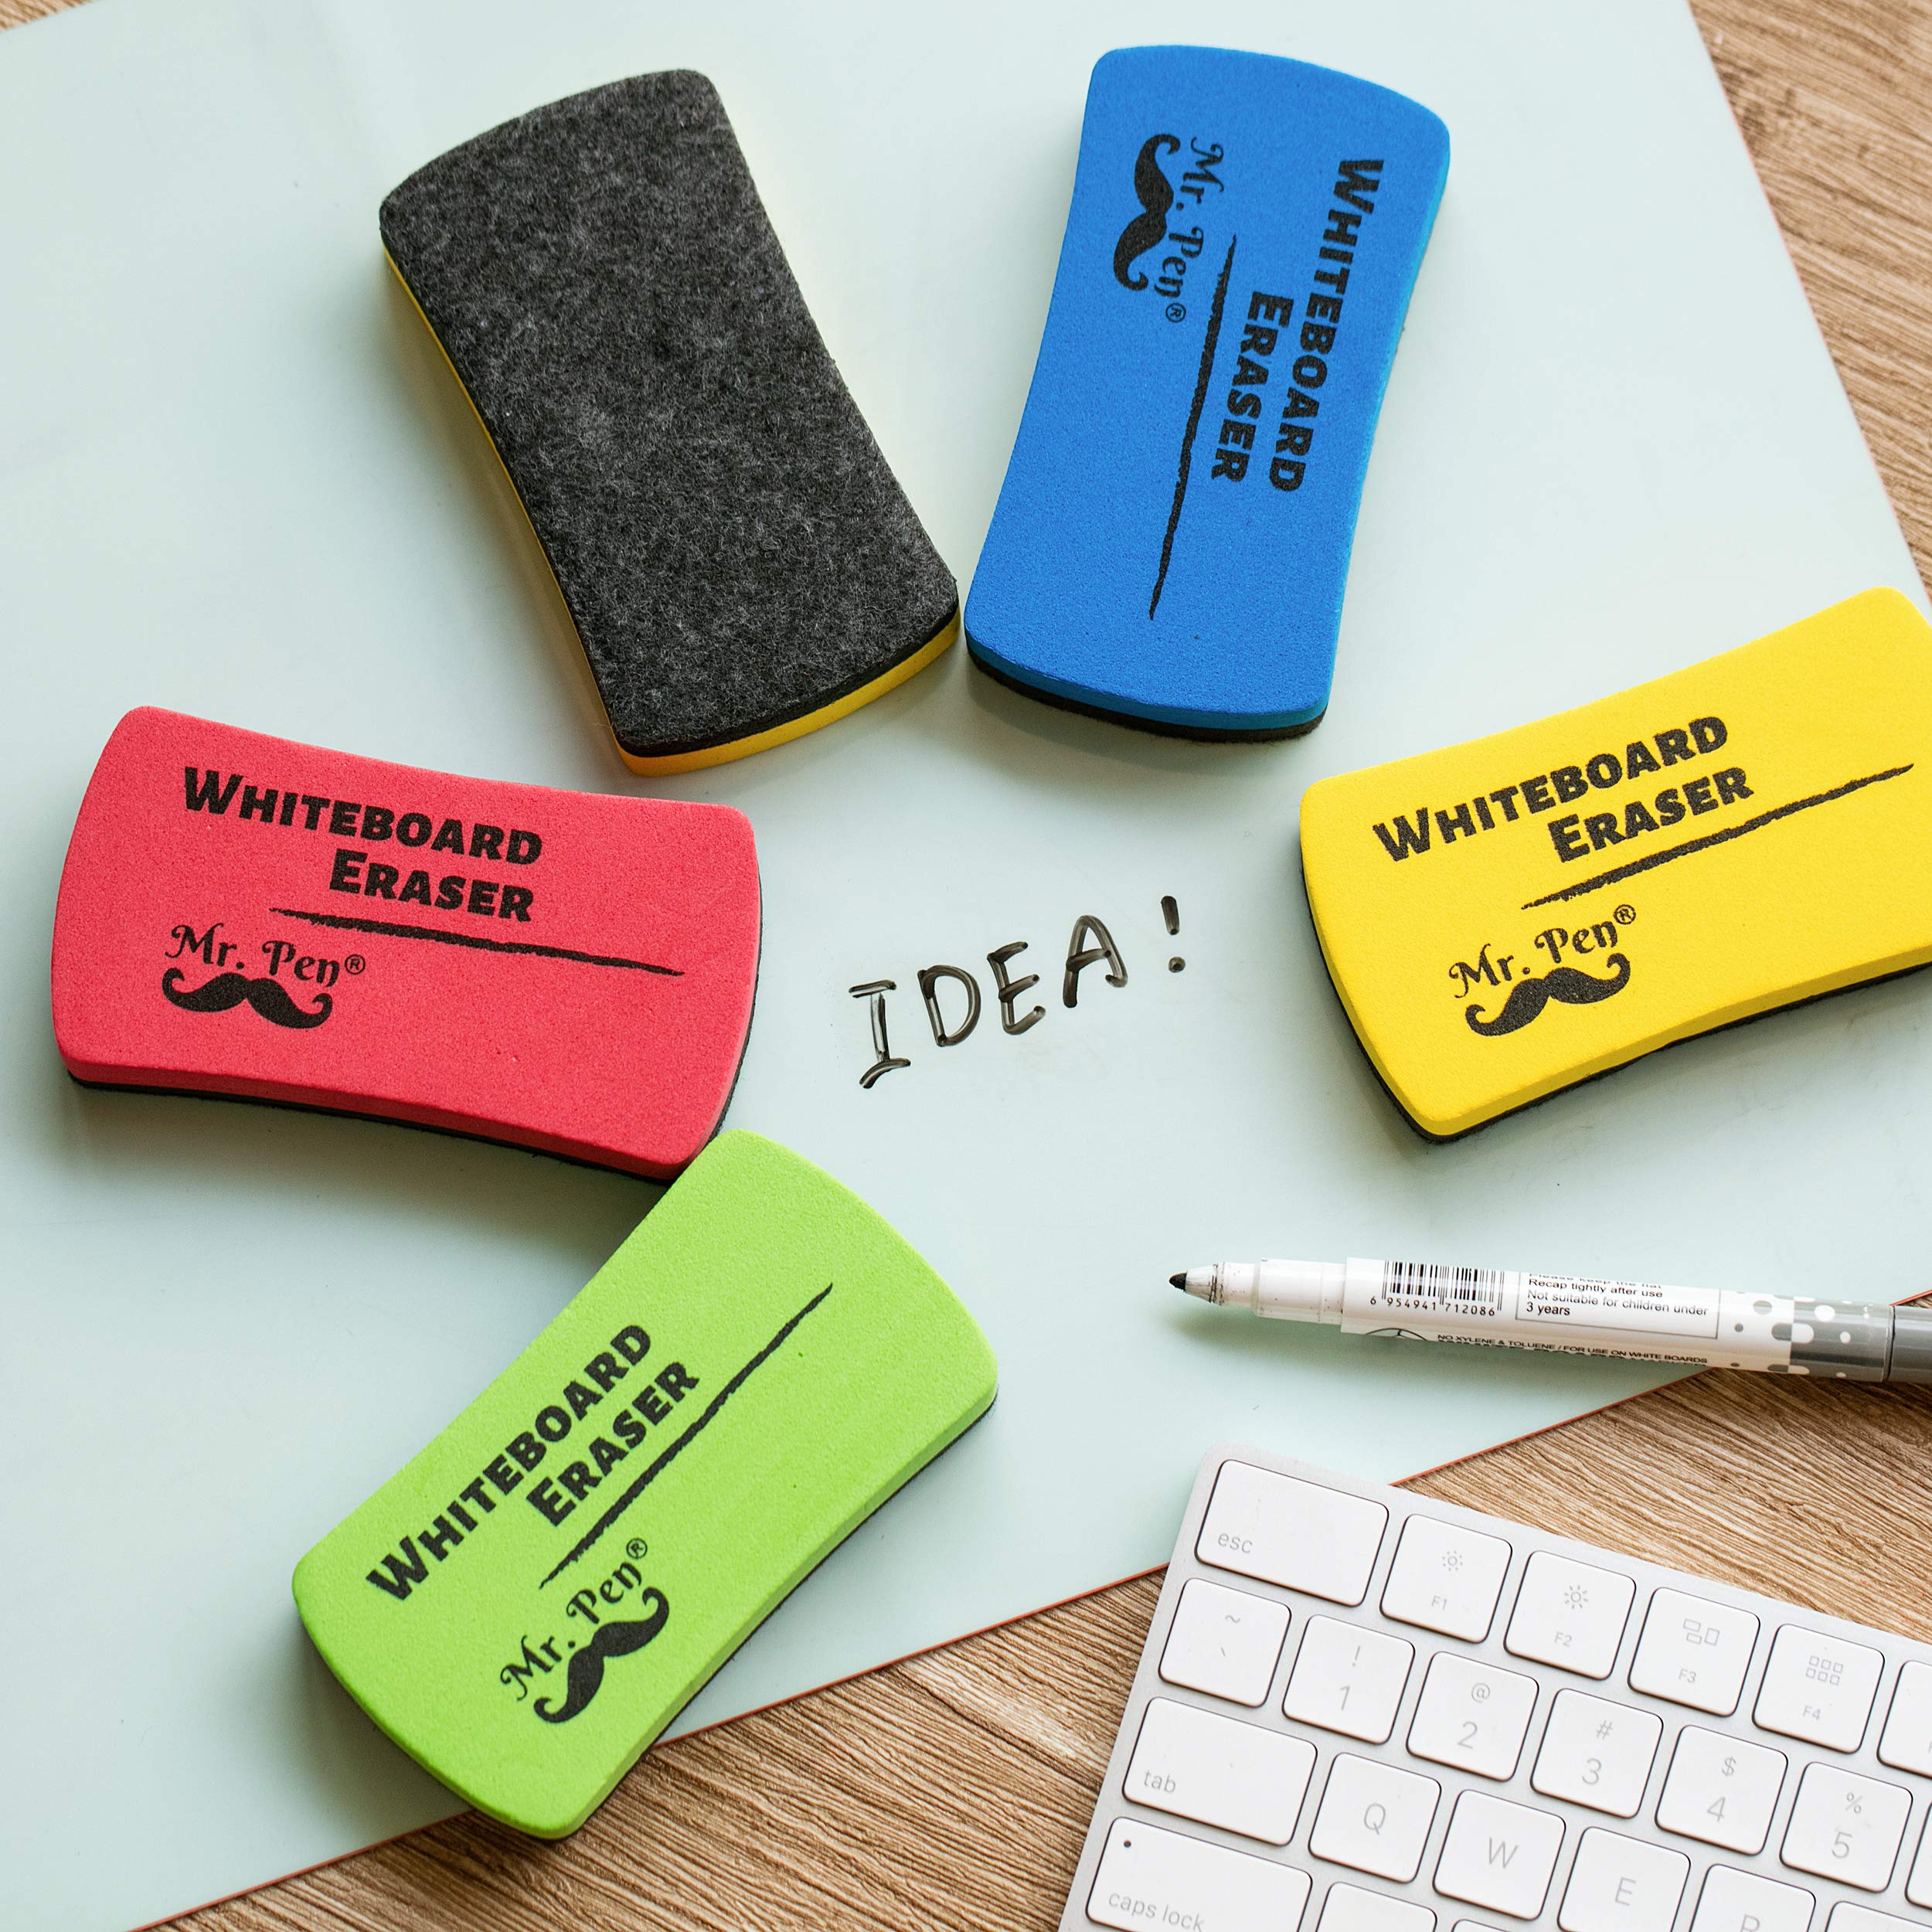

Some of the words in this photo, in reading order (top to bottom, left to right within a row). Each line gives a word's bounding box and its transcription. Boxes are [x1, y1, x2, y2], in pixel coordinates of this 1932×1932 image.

[1175, 136, 1224, 212] Mr.
[164, 923, 245, 970] Mr.
[1449, 943, 1531, 998] Mr.
[1529, 1278, 1567, 1290] Recap
[1571, 1283, 1607, 1293] tightly
[1611, 1287, 1637, 1295] after
[1526, 1301, 1533, 1312] 3
[1537, 1304, 1570, 1316] years
[1527, 1289, 1549, 1301] Not
[1552, 1291, 1599, 1305] suitable
[1603, 1296, 1618, 1308] for
[1622, 1298, 1669, 1312] children
[1673, 1304, 1708, 1316] under
[1455, 1335, 1496, 1345] XYLENE
[1508, 1340, 1556, 1350] TOLUENE
[1628, 1352, 1662, 1360] WHITE
[1664, 1355, 1708, 1364] BOARDS
[1217, 1532, 1253, 1555] esc
[1430, 1595, 1447, 1611] F1
[1554, 1631, 1573, 1648] F2
[499, 1634, 577, 1701] Mr.
[1678, 1668, 1697, 1684] F3
[1339, 1685, 1351, 1711] 1
[1471, 1682, 1492, 1704] @
[1802, 1705, 1821, 1721] F4
[1457, 1720, 1478, 1750] 2
[1596, 1719, 1613, 1740] #
[1581, 1757, 1603, 1786] 3
[1721, 1756, 1737, 1777] $
[1143, 1770, 1177, 1794] tab
[1706, 1796, 1727, 1823] 4
[1845, 1792, 1862, 1815] %
[1362, 1802, 1387, 1836] Q
[1488, 1837, 1519, 1869] W
[1831, 1831, 1853, 1859] 5
[1614, 1876, 1637, 1906] E
[1108, 1893, 1157, 1919] caps
[1162, 1903, 1205, 1932] lock
